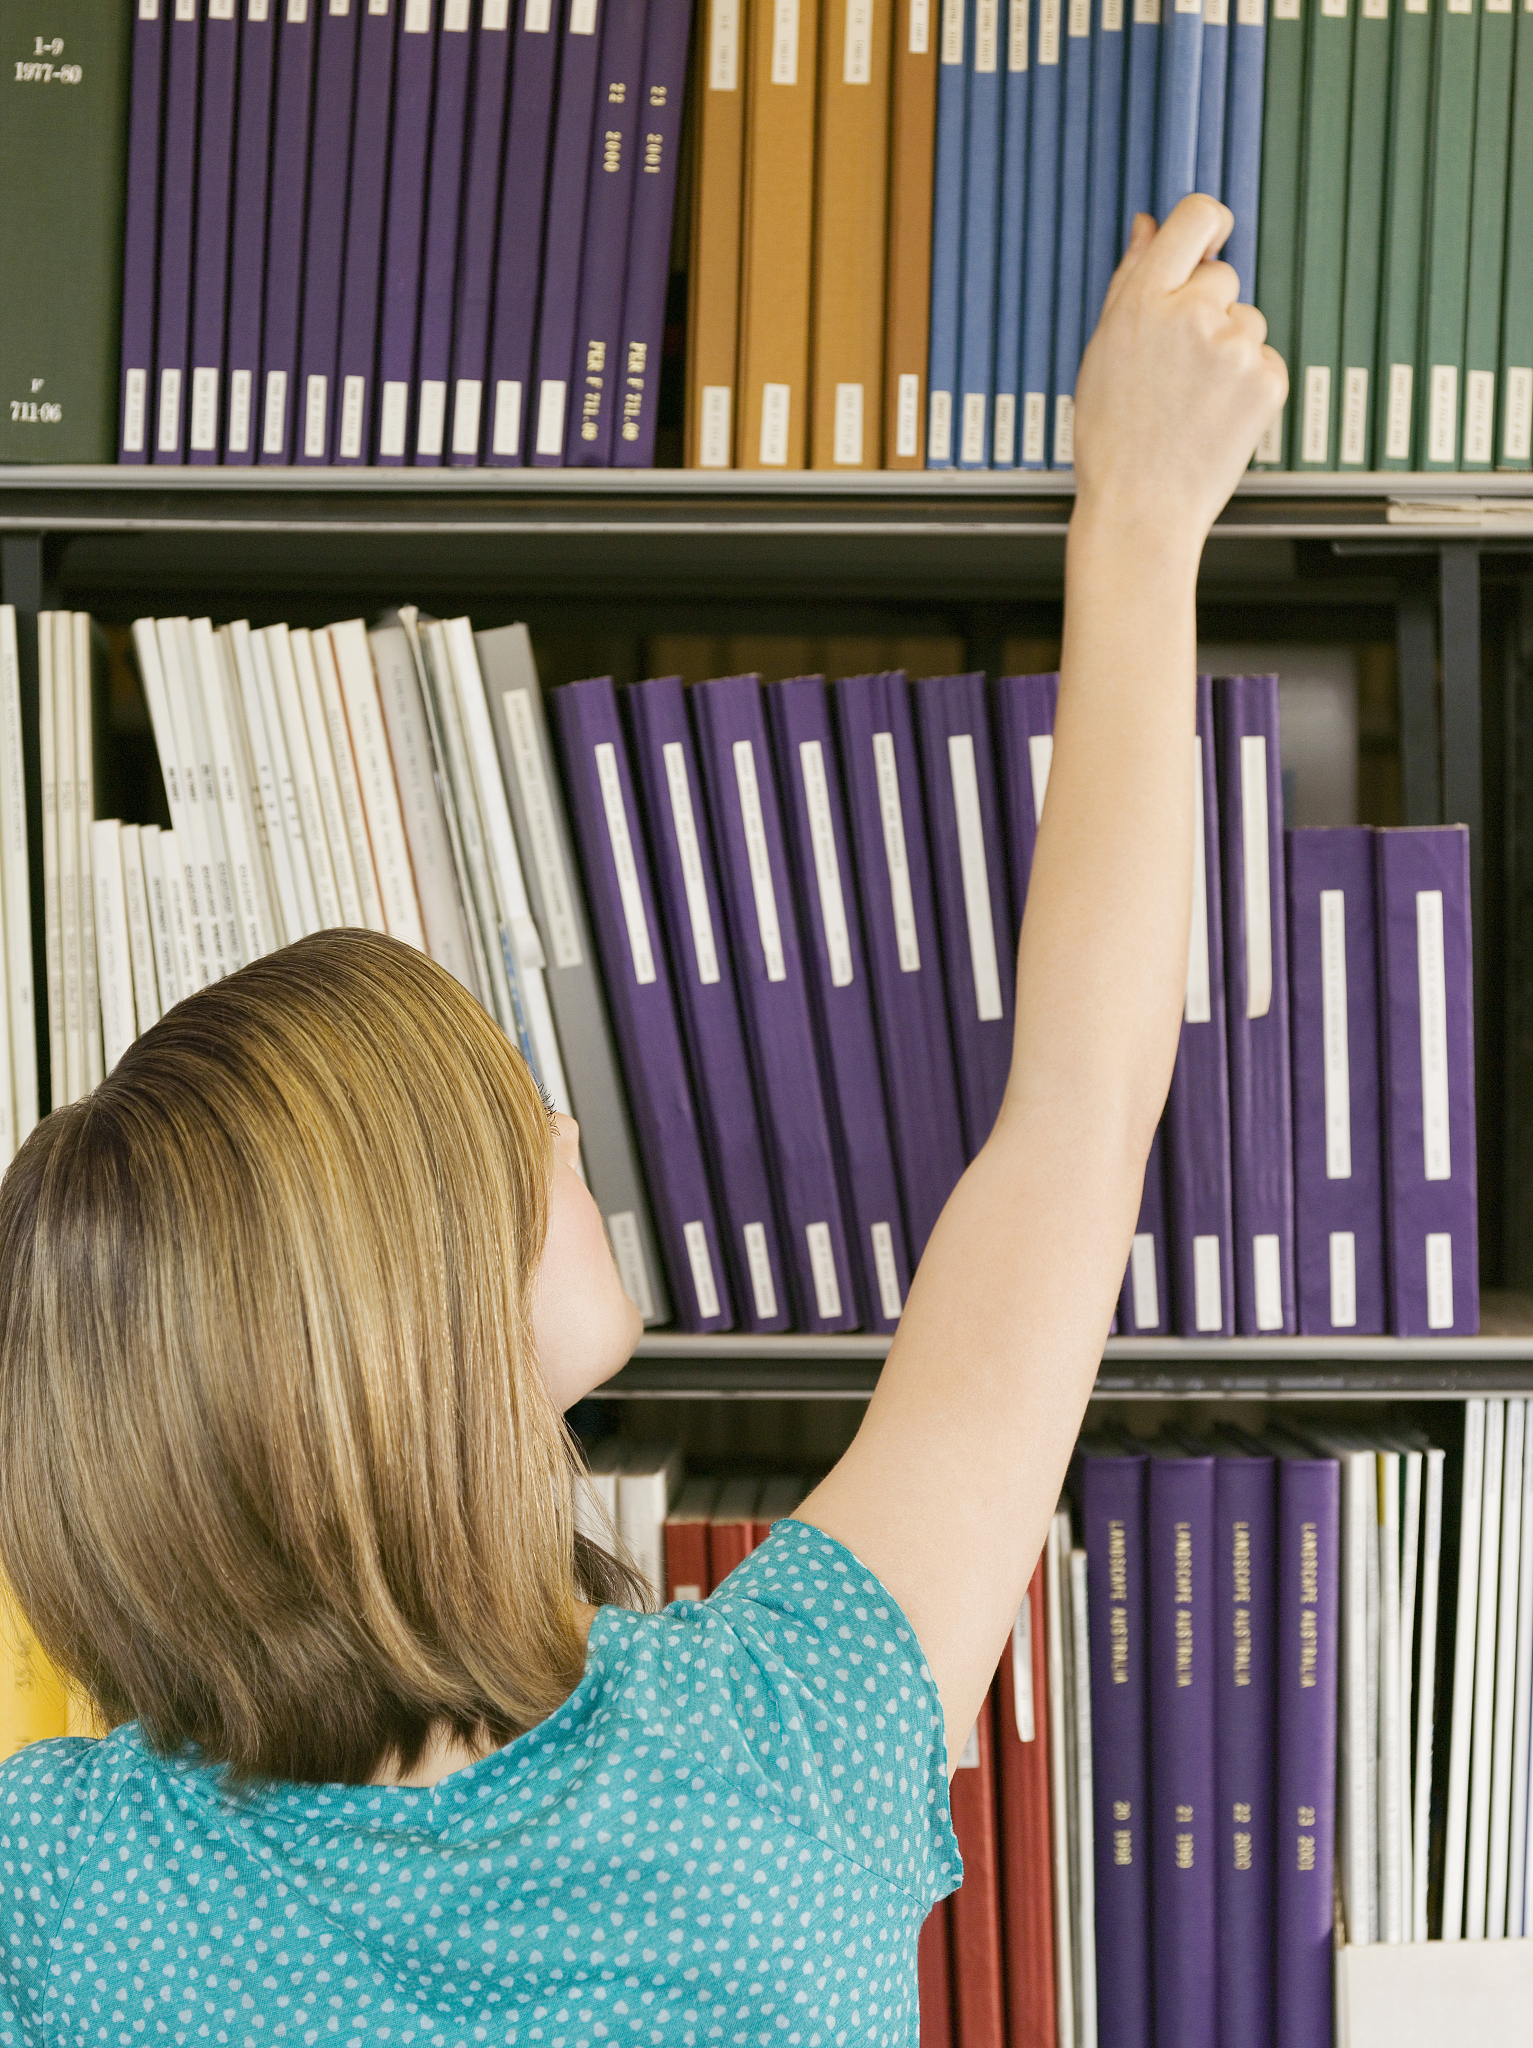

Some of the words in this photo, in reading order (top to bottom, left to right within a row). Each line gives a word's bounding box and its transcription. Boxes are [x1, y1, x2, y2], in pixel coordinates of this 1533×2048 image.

[34, 36, 65, 56] 1-9
[608, 82, 626, 103] 22
[649, 85, 667, 106] 23
[603, 130, 622, 172] 2000
[643, 132, 663, 173] 2001
[586, 340, 606, 372] PER
[627, 341, 647, 373] PER
[585, 376, 604, 390] F
[626, 377, 645, 391] F
[1109, 1520, 1127, 1600] LANDSCAPE
[1174, 1522, 1192, 1603] LANDSCAPE
[1232, 1521, 1250, 1603] LANDSCAPE
[1300, 1522, 1318, 1603] LANDSCAPE
[1110, 1607, 1129, 1684] AUSTRALIA
[1175, 1609, 1193, 1688] AUSTRALIA
[1233, 1608, 1252, 1687] AUSTRALIA
[1299, 1609, 1317, 1688] AUSTRALIA
